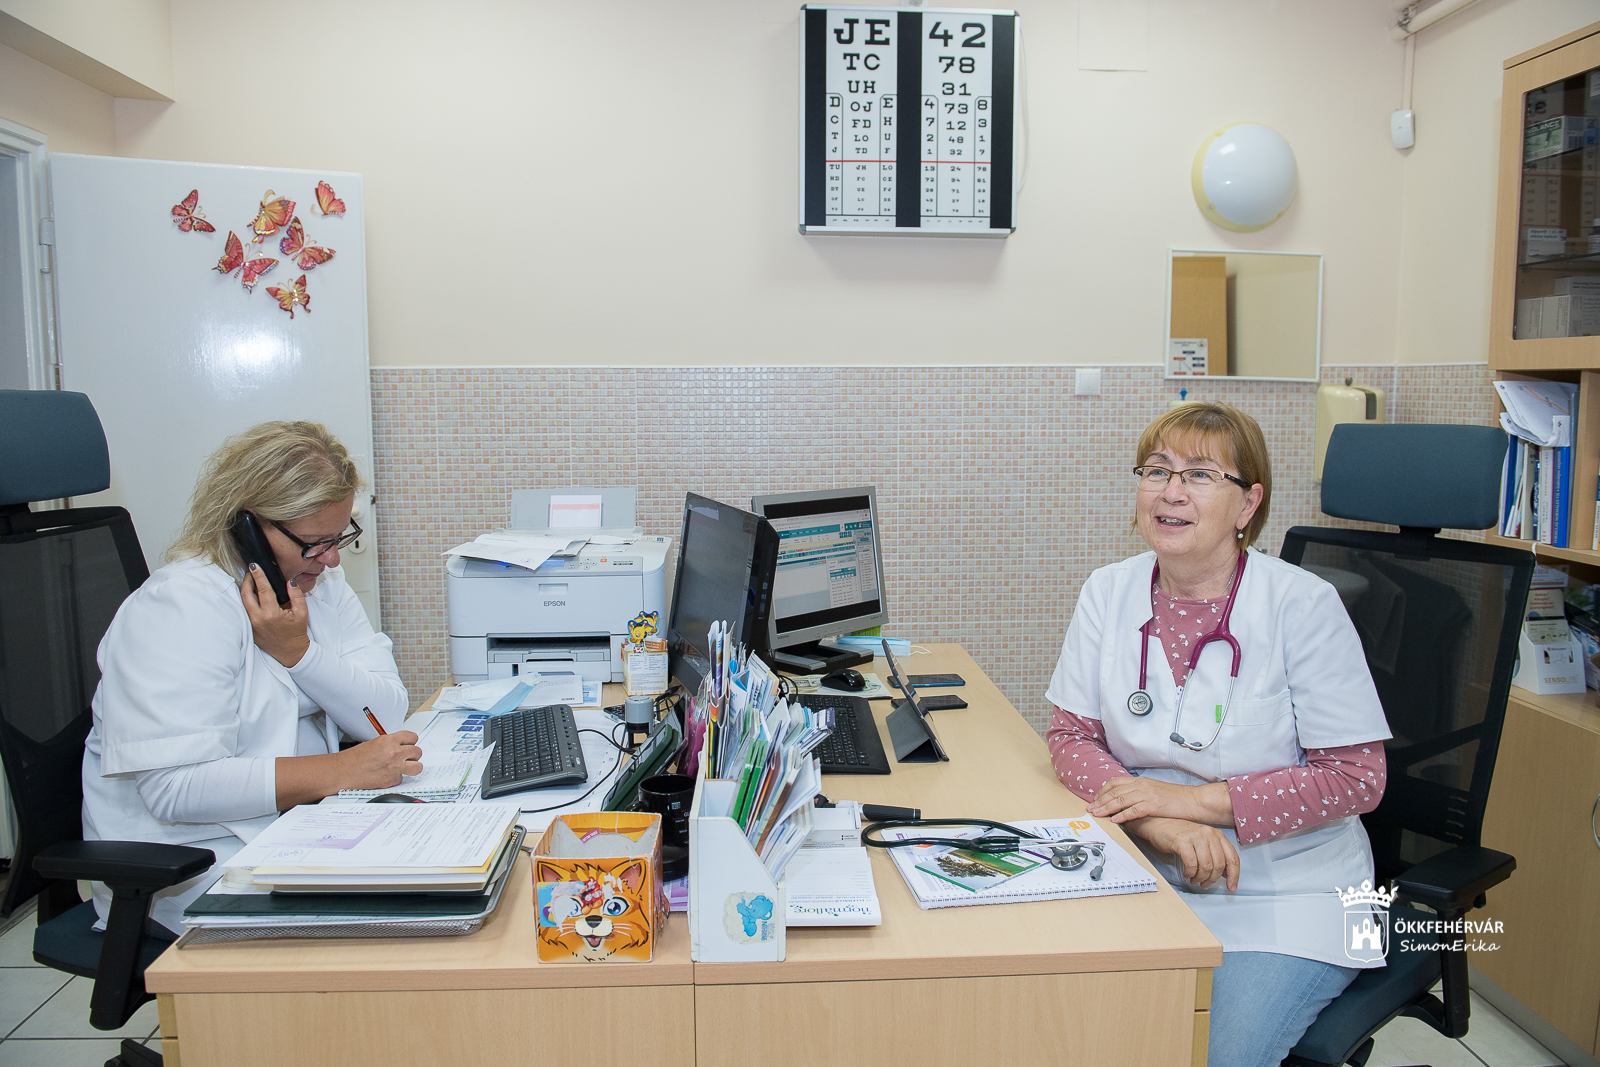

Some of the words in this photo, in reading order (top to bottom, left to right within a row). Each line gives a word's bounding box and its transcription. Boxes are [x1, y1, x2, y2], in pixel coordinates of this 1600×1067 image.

[834, 18, 890, 45] JE
[929, 22, 985, 48] 42
[843, 53, 880, 70] TC
[939, 56, 975, 73] 78
[848, 80, 875, 93] UH
[942, 83, 971, 96] 31
[830, 95, 841, 107] D
[851, 102, 872, 112] OJ
[882, 96, 893, 108] E
[925, 98, 934, 109] 4
[945, 103, 968, 114] 73
[978, 100, 987, 110] 8
[831, 115, 838, 124] C
[852, 119, 871, 128] FD
[884, 117, 892, 125] H
[926, 117, 934, 126] 7
[947, 121, 966, 130] 12
[978, 119, 987, 127] 3
